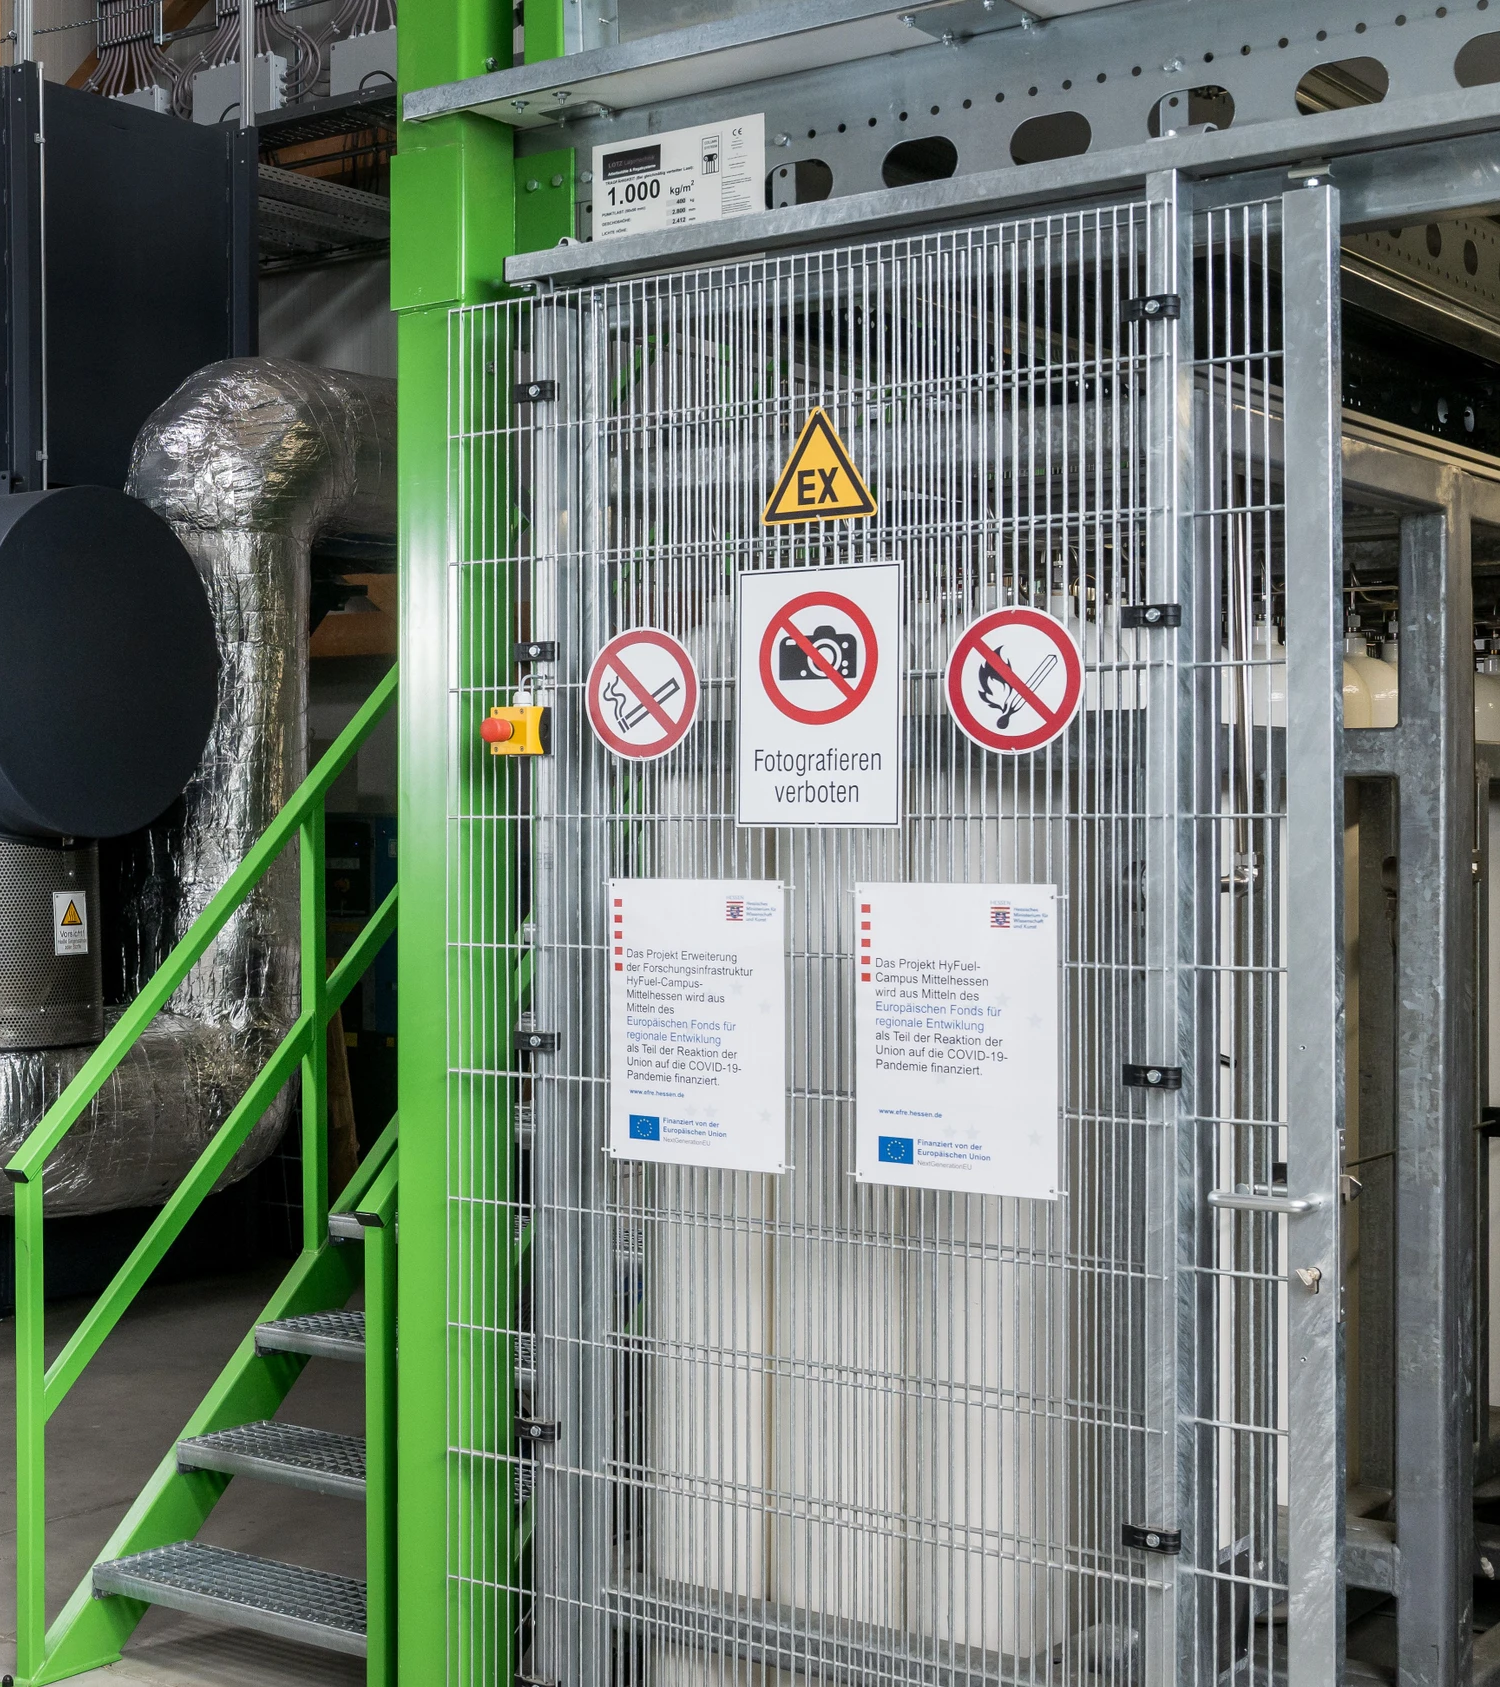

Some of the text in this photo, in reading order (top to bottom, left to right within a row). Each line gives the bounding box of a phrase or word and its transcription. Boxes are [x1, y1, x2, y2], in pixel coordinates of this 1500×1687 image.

[607, 179, 660, 206] 1.000
[797, 467, 839, 506] EX
[753, 748, 883, 777] Fotografieren
[774, 780, 860, 804] verboten
[59, 930, 85, 938] Vorsicht!
[627, 949, 738, 964] Das Projekt Erweiterung
[627, 963, 753, 977] der Forschungsinfrastruktur
[875, 957, 981, 972] Das Projekt HyFuel-
[627, 976, 703, 989] HyFuel-Campus-
[875, 972, 989, 987] Campus Mittelhessen
[627, 989, 725, 1003] Mittelhessen wird aus
[875, 987, 980, 1001] wird aus Mitteln des
[627, 1003, 675, 1014] Mitteln des
[875, 1001, 1002, 1017] Europäischen Fonds für
[627, 1016, 736, 1031] Europäischen Fonds für
[875, 1016, 985, 1033] regionale Entwiklung
[627, 1031, 721, 1047] regionale Entwiklung
[875, 1031, 1003, 1047] als Teil der Reaktion der
[627, 1044, 737, 1059] als Teil der Reaktion der
[875, 1045, 1008, 1062] Union auf die COVID-19-
[627, 1057, 742, 1073] Union auf die COVID-19-
[875, 1059, 983, 1076] Pandemie finanziert.
[627, 1070, 720, 1086] Pandemie finanziert.
[629, 1089, 685, 1098] www.efre.hessen.de
[878, 1108, 943, 1119] www.efre.hessen.de
[663, 1117, 694, 1126] Finanziert
[663, 1127, 727, 1138] Europäischen Union
[663, 1137, 711, 1146] NextGenerationEU
[917, 1139, 982, 1151] Finanziert von der
[917, 1149, 991, 1162] Europäischen Union
[917, 1160, 972, 1170] NextGenerationEU
